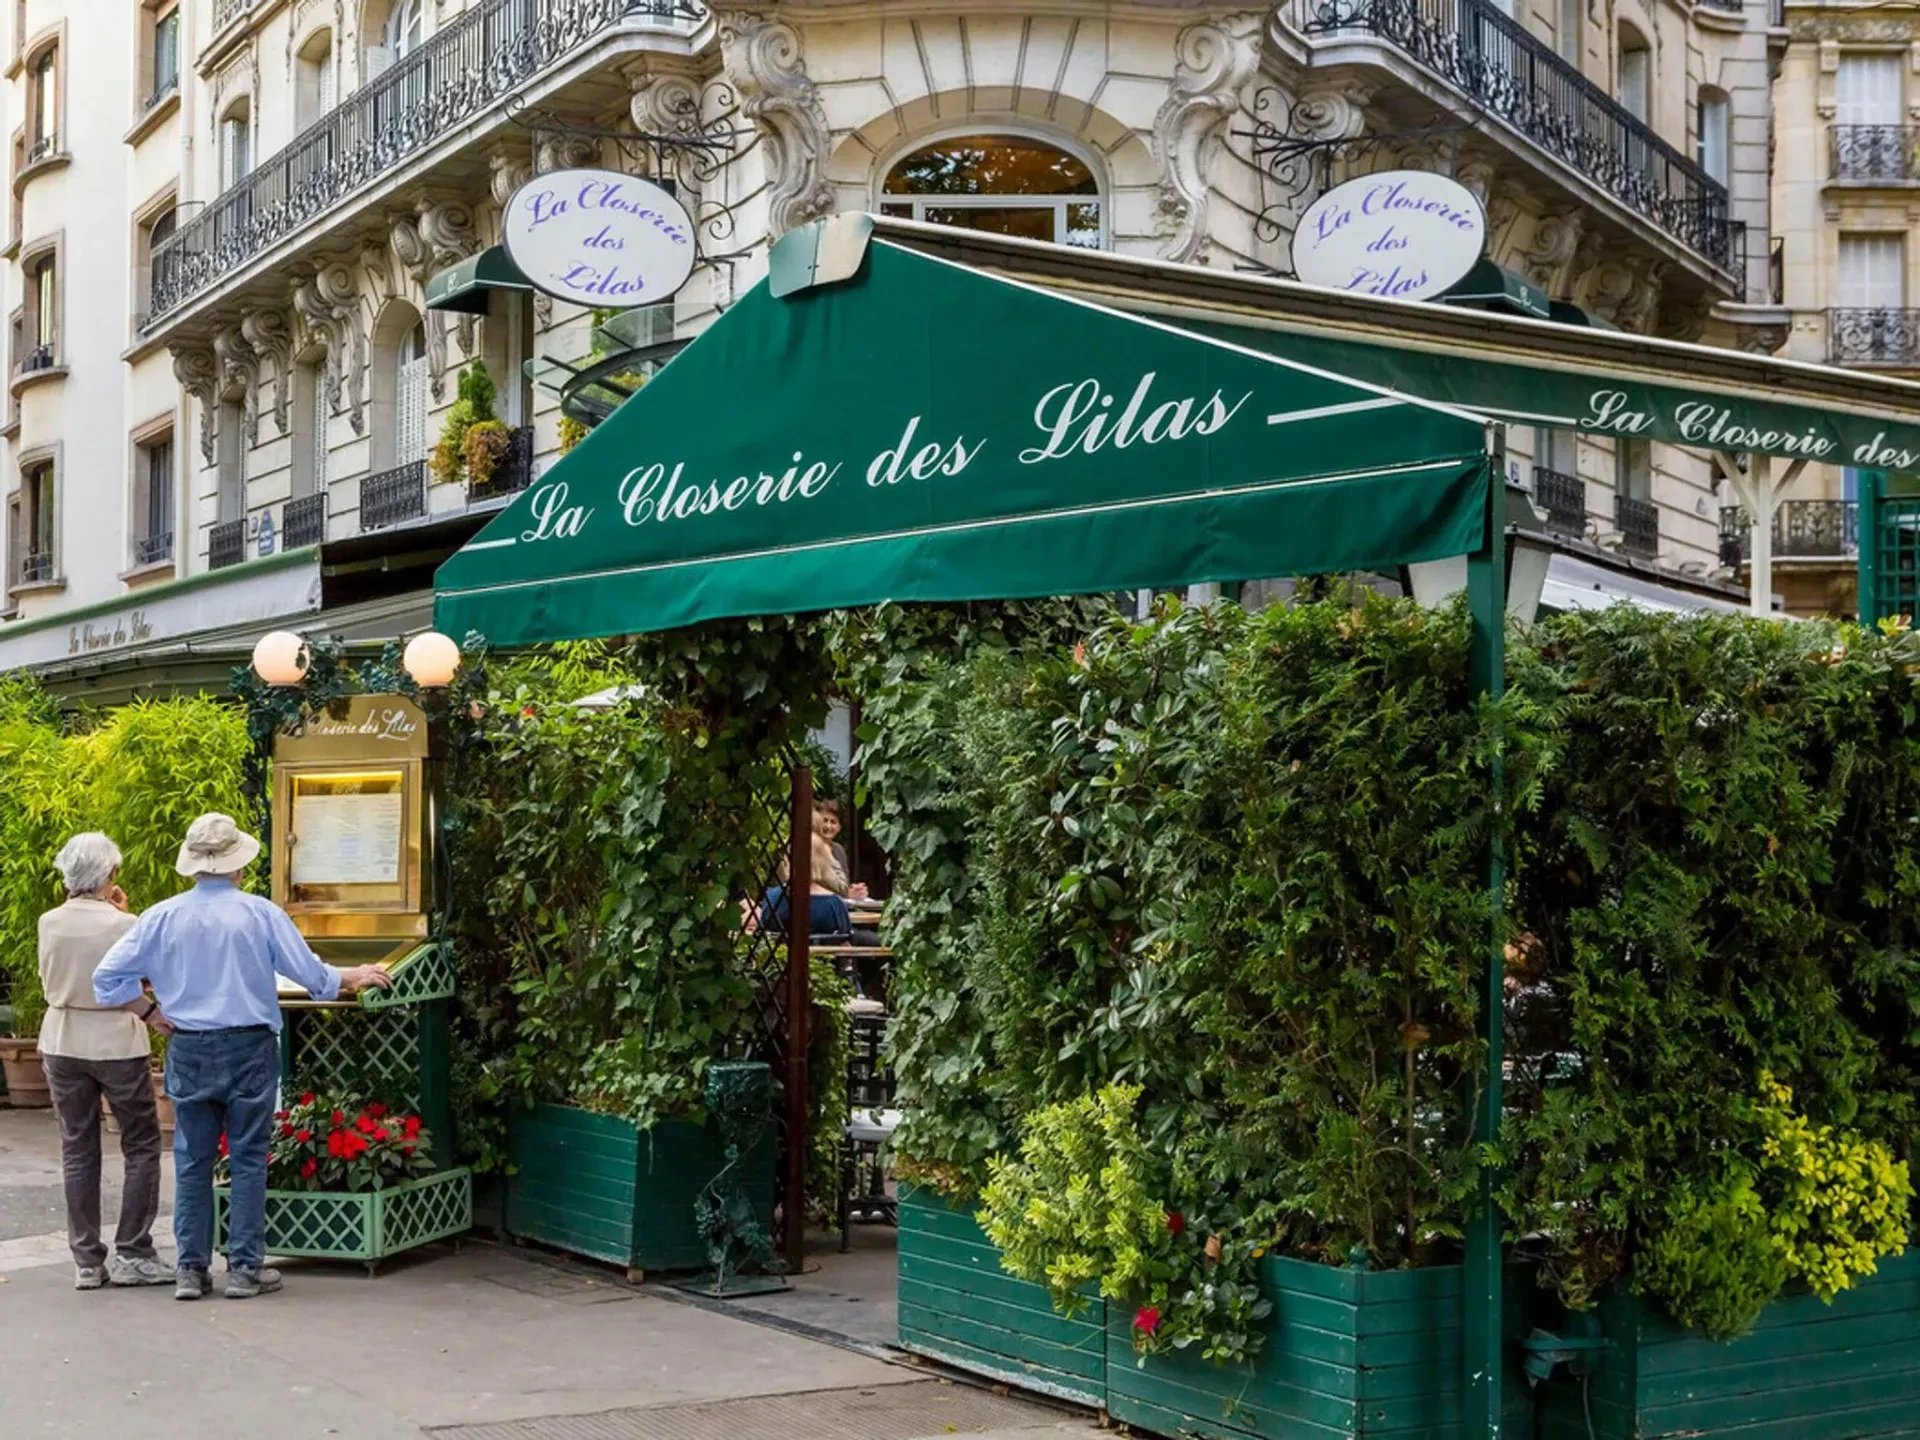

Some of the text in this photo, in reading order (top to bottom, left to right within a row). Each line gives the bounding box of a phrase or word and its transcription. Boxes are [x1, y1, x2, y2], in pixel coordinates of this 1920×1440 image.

[524, 177, 688, 246] La Closerie
[1311, 181, 1475, 249] La Closerie
[583, 225, 625, 251] des
[1366, 225, 1409, 252] des
[550, 260, 645, 295] Lilas
[1580, 389, 1920, 469] La Closerie des
[520, 371, 1255, 543] La Closerie des Lilas
[358, 708, 380, 734] des
